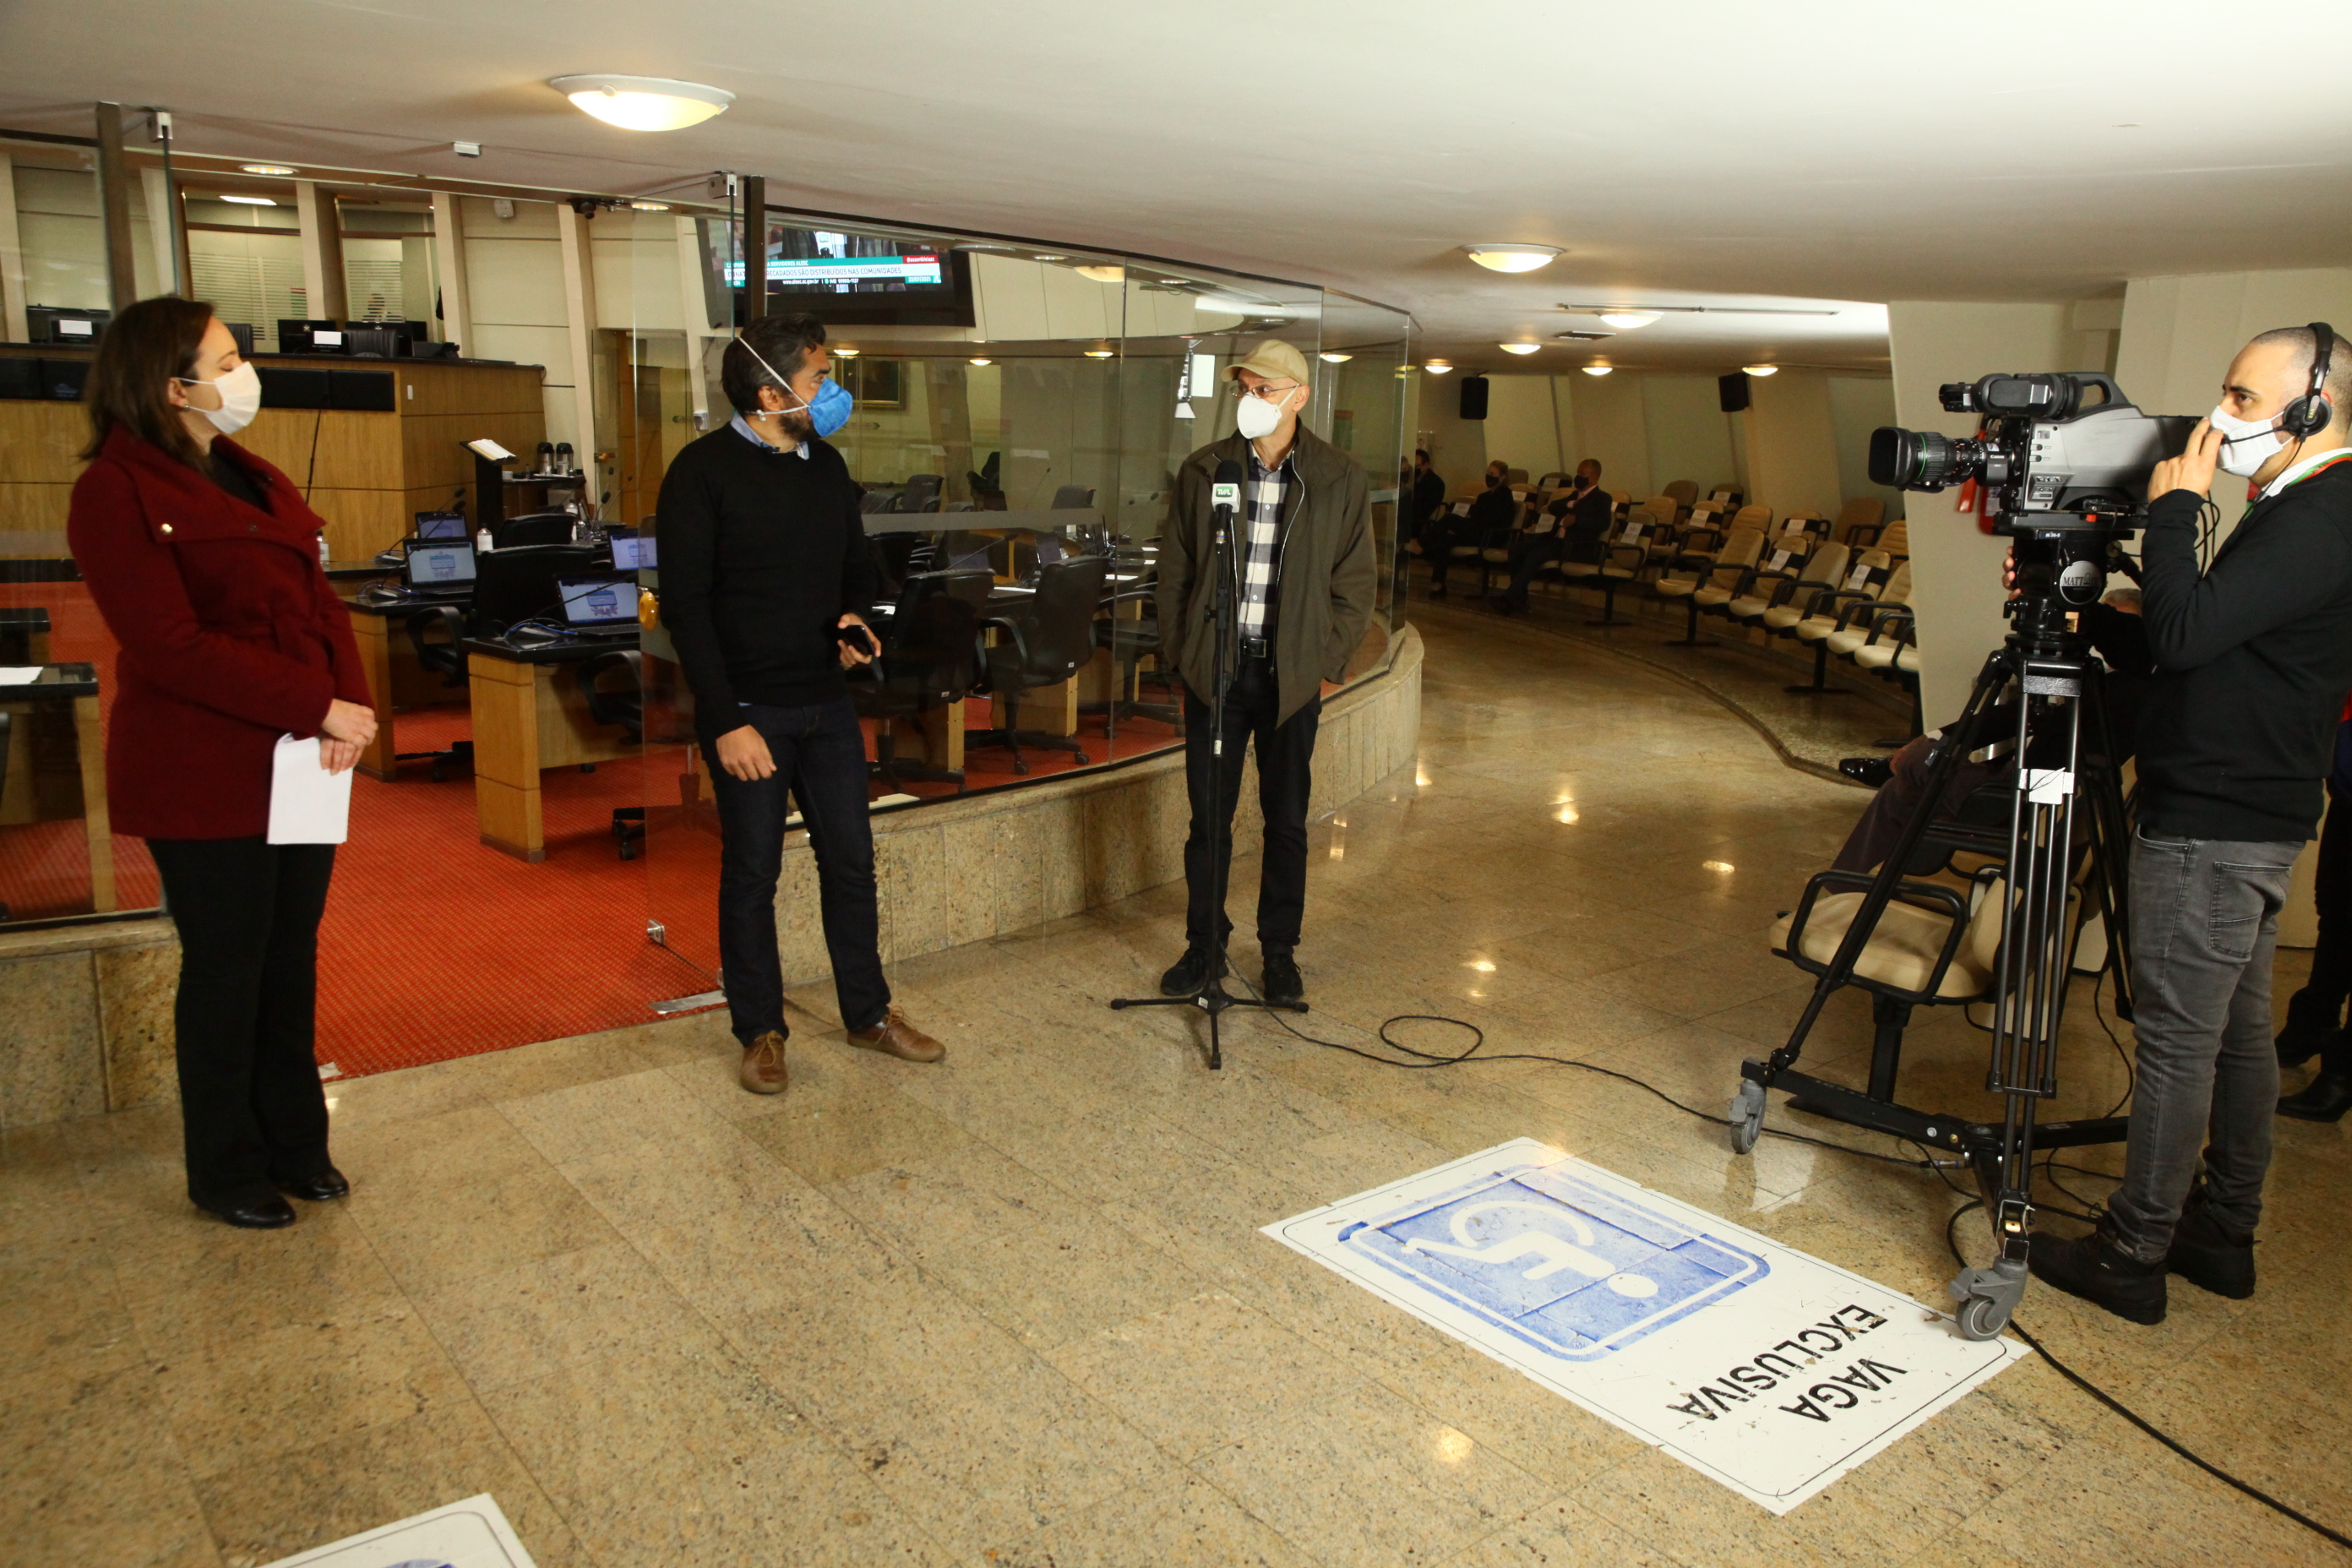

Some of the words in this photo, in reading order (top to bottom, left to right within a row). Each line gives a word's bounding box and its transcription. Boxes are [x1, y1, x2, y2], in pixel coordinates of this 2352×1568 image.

[811, 267, 847, 276] DISTRIBUÍDOS
[1665, 1304, 1889, 1421] EXCLUSIVA
[1778, 1358, 1908, 1423] VAGA
